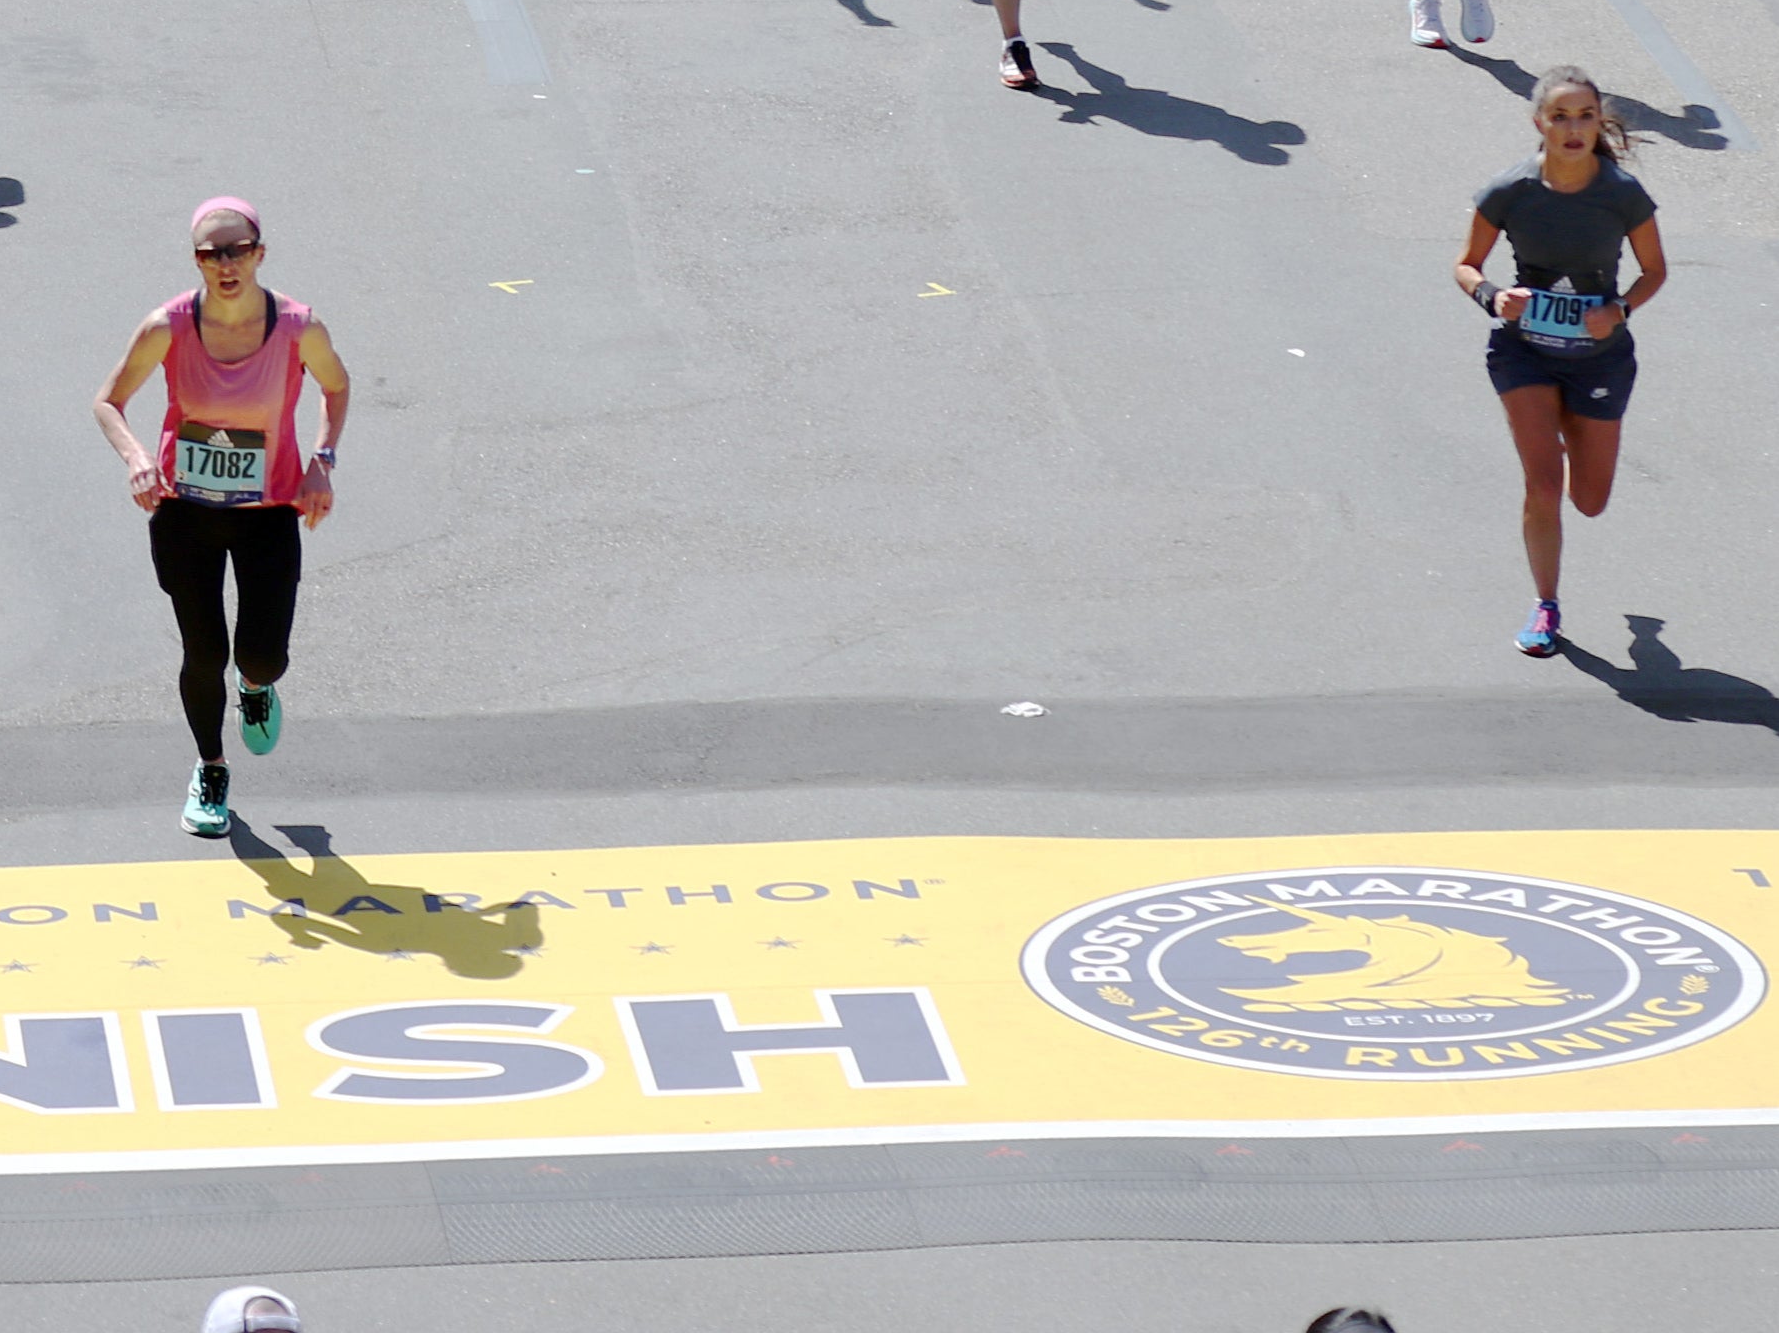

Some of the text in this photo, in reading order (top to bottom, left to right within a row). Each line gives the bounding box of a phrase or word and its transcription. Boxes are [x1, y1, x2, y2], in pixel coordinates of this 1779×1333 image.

[184, 445, 256, 480] 17082
[225, 877, 923, 921] MARATHON
[1068, 876, 1716, 985] BOSTON MARATHON
[1126, 1004, 1313, 1056] 126th
[1342, 1009, 1496, 1030] EST. 1897
[1344, 995, 1706, 1070] RUNNING
